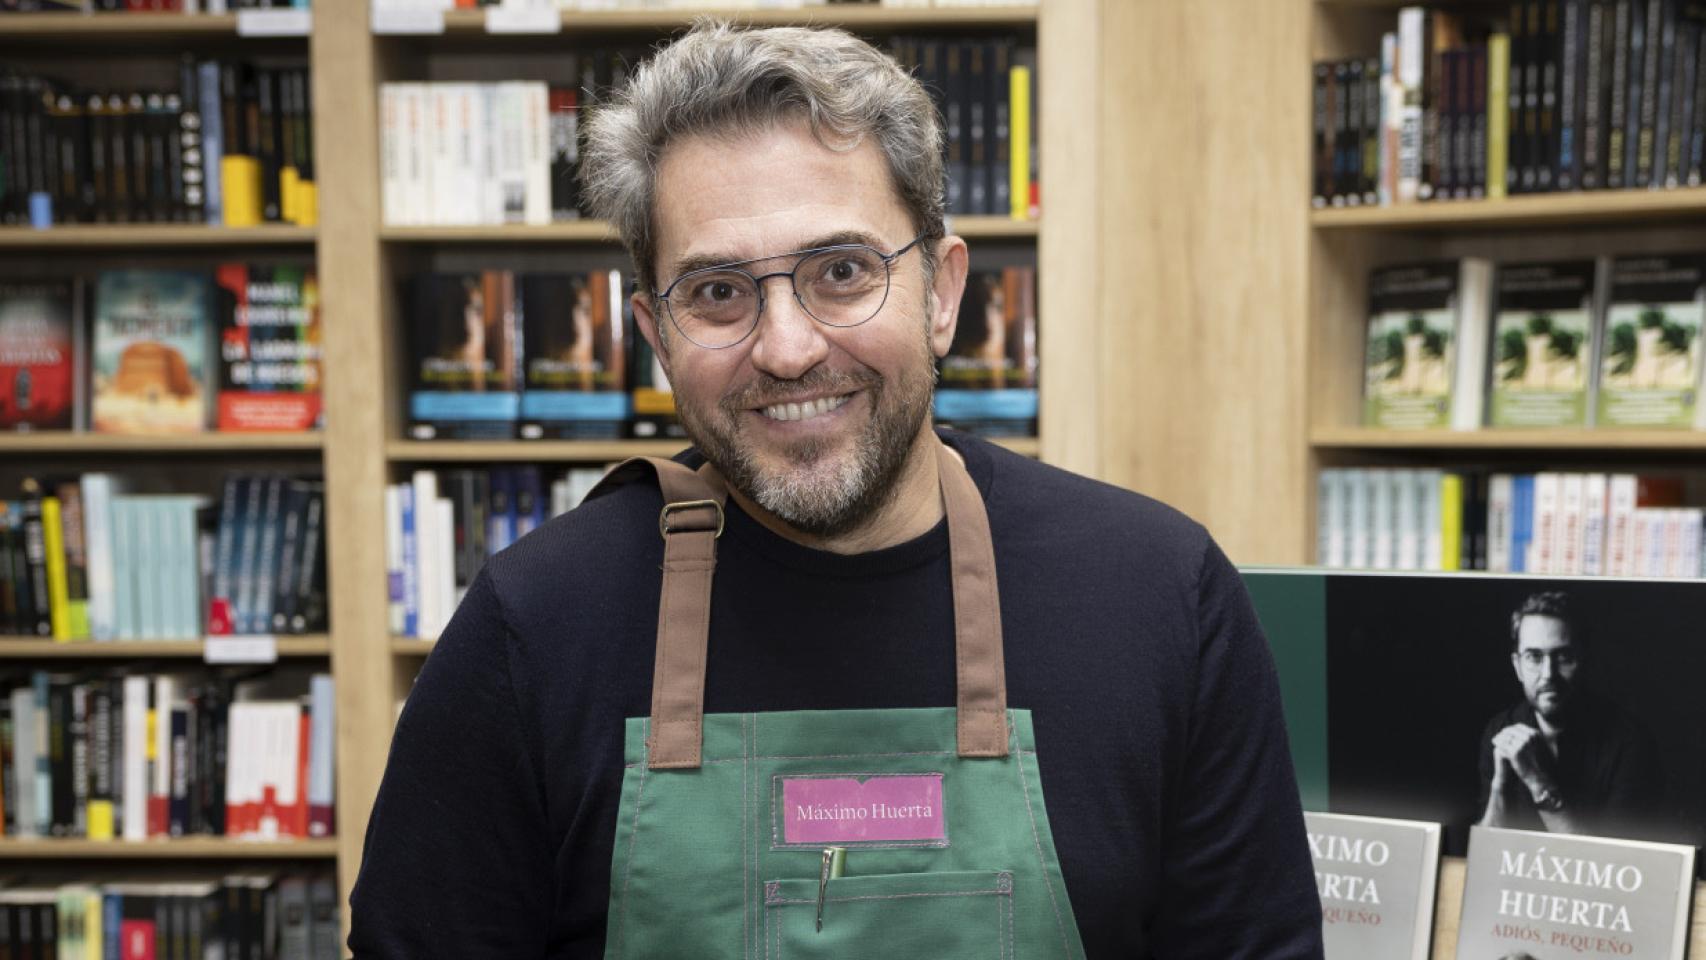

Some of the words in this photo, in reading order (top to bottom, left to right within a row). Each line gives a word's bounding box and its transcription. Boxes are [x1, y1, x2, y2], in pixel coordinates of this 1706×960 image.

[797, 803, 867, 821] Máximo
[872, 803, 932, 819] Huerta
[1307, 832, 1390, 867] XIMO
[1499, 847, 1643, 893] MÁXIMO
[1315, 871, 1381, 904] RTA
[1323, 906, 1382, 926] QUEÑO
[1498, 889, 1634, 933] HUERTA
[1551, 930, 1634, 956] PEQUEÑO
